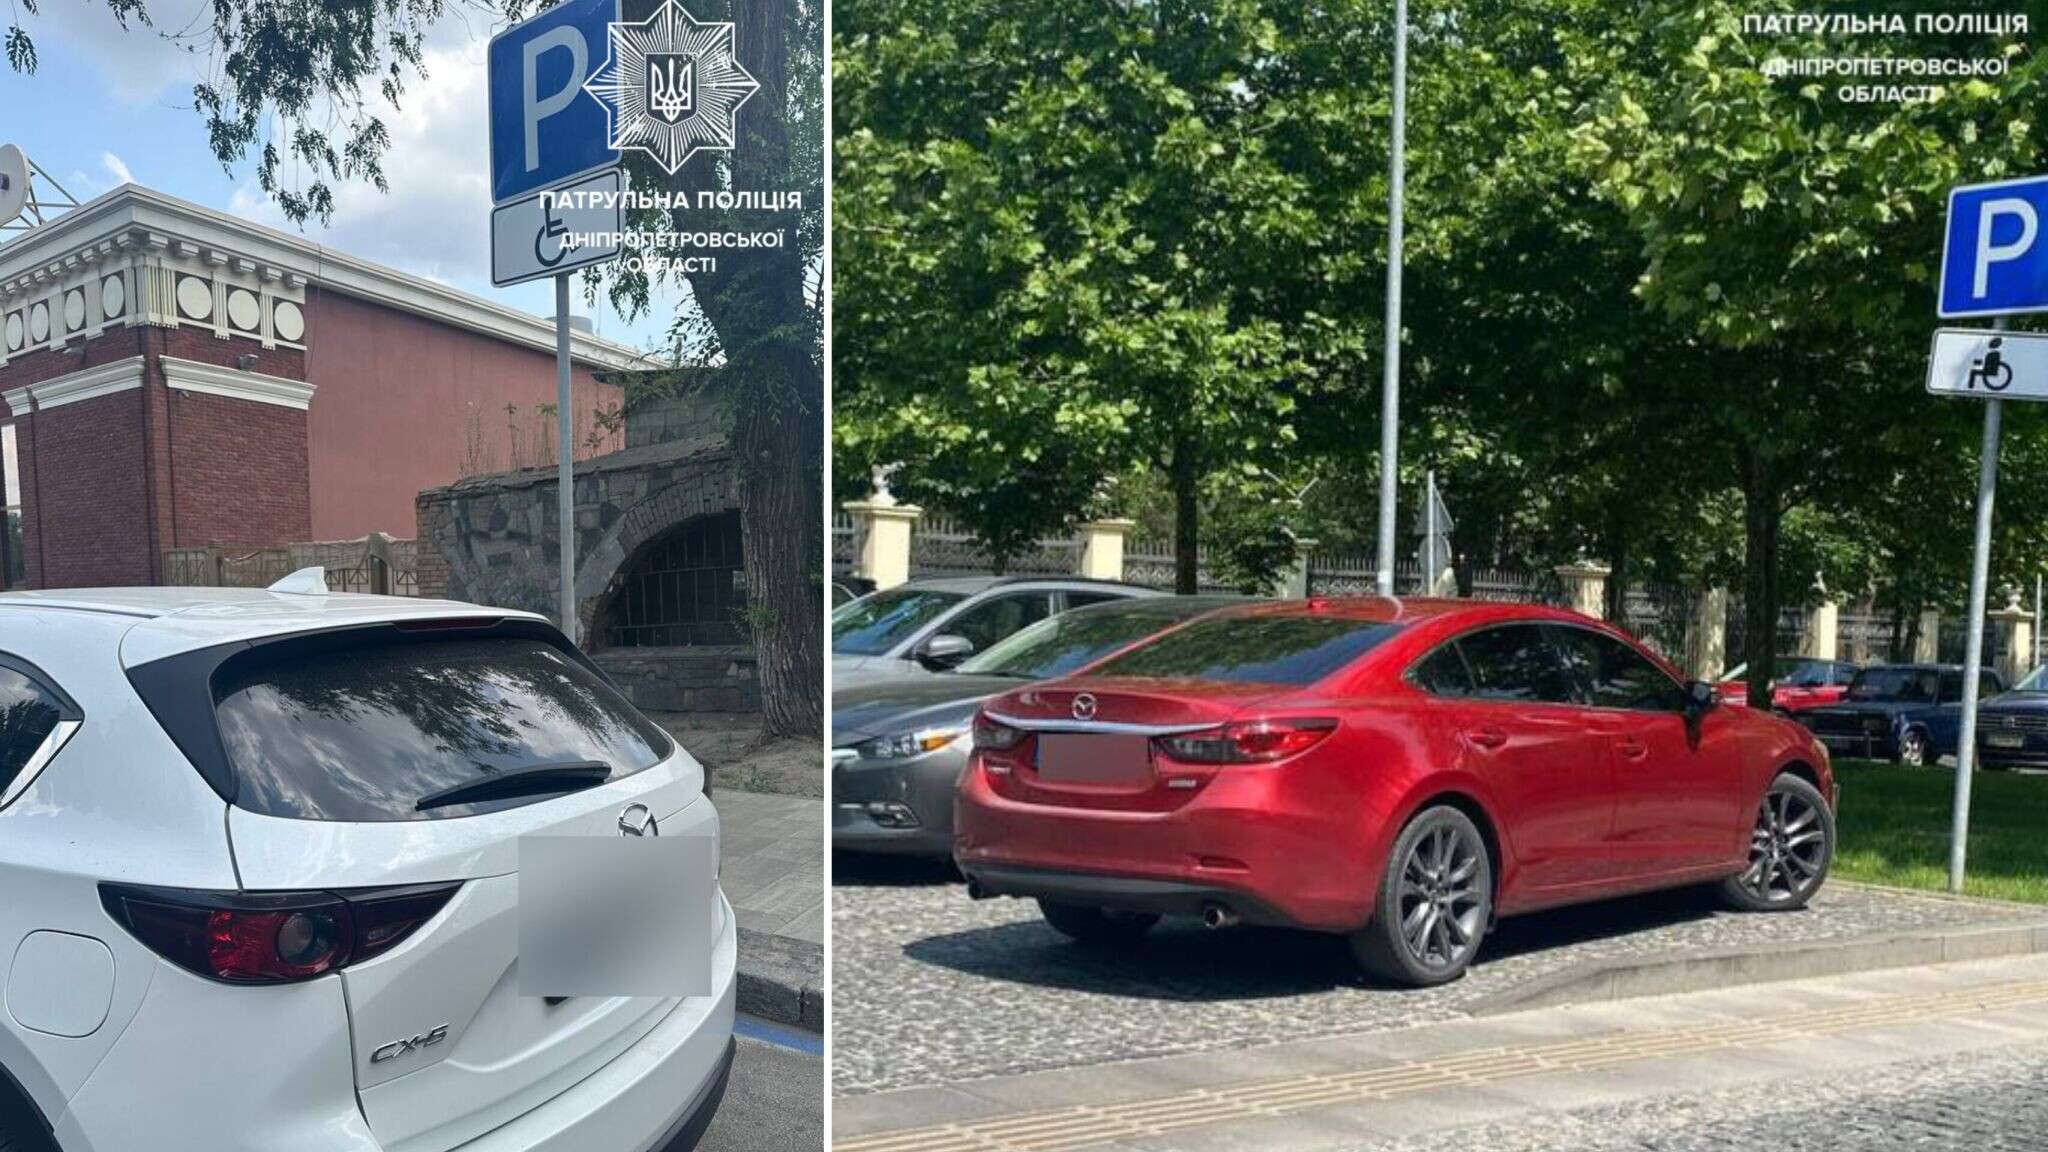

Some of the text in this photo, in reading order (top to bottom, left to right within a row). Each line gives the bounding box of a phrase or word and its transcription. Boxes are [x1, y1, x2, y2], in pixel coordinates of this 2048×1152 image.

[523, 25, 589, 173] P
[1972, 198, 2039, 298] P
[370, 1023, 448, 1063] CX-5
